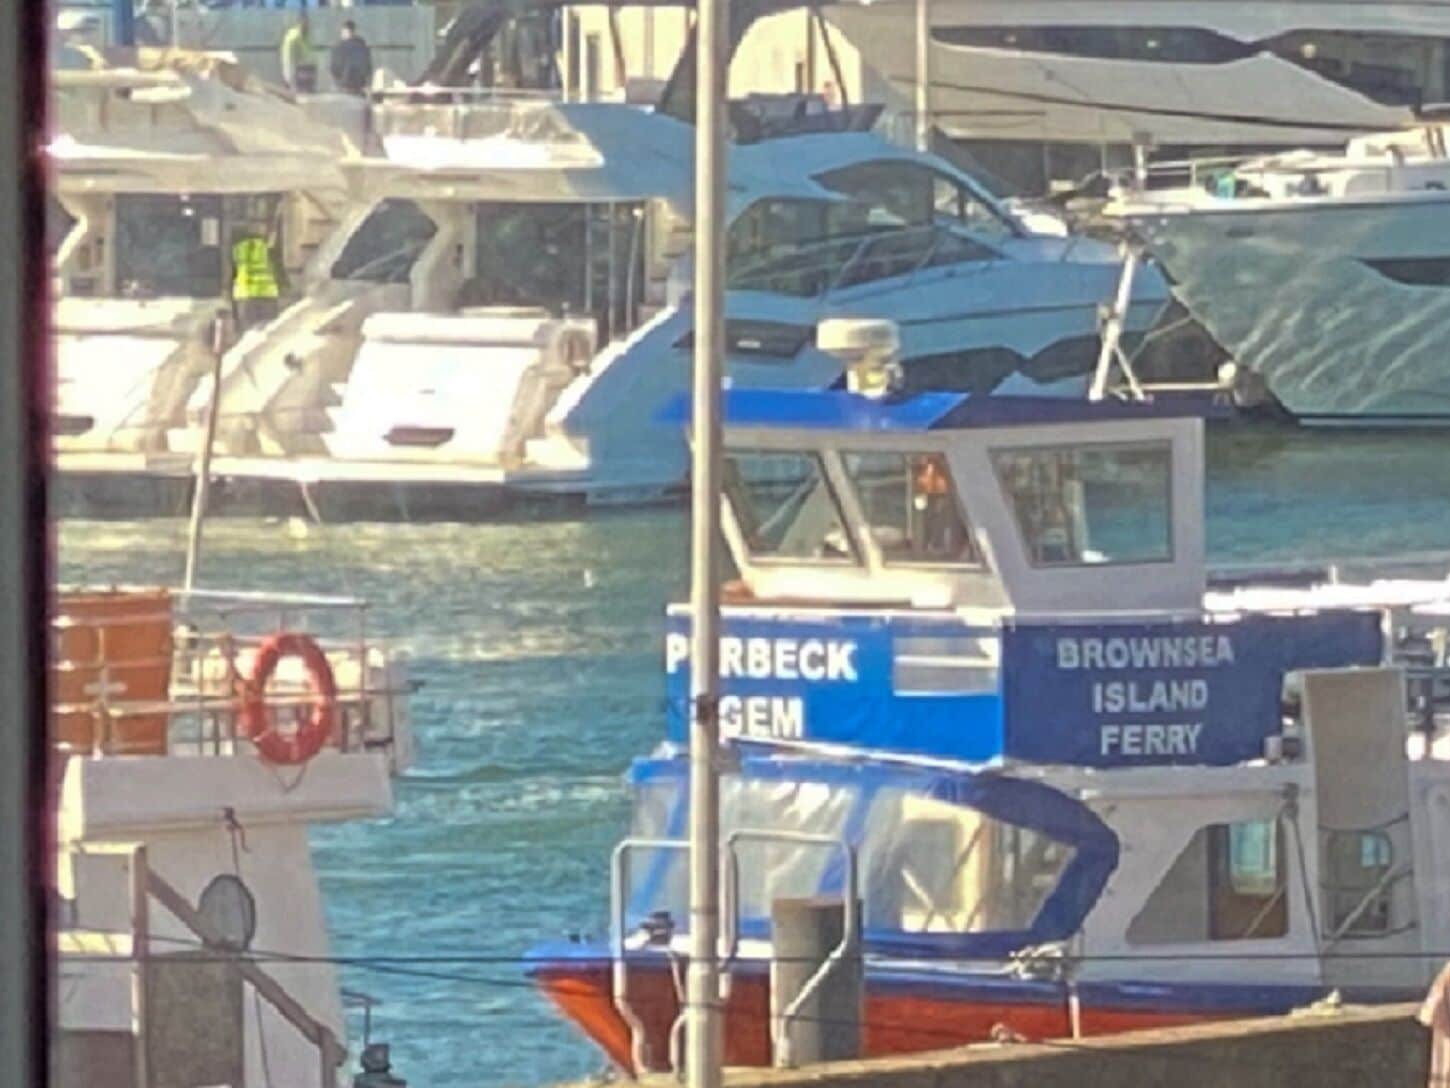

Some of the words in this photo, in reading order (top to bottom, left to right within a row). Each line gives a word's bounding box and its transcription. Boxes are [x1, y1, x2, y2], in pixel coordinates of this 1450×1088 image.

[666, 633, 858, 682] PRBECK
[1057, 636, 1234, 669] BROWNSEA
[1094, 679, 1208, 713] ISLAND
[718, 695, 805, 738] GEM
[1101, 724, 1202, 755] FERRY
